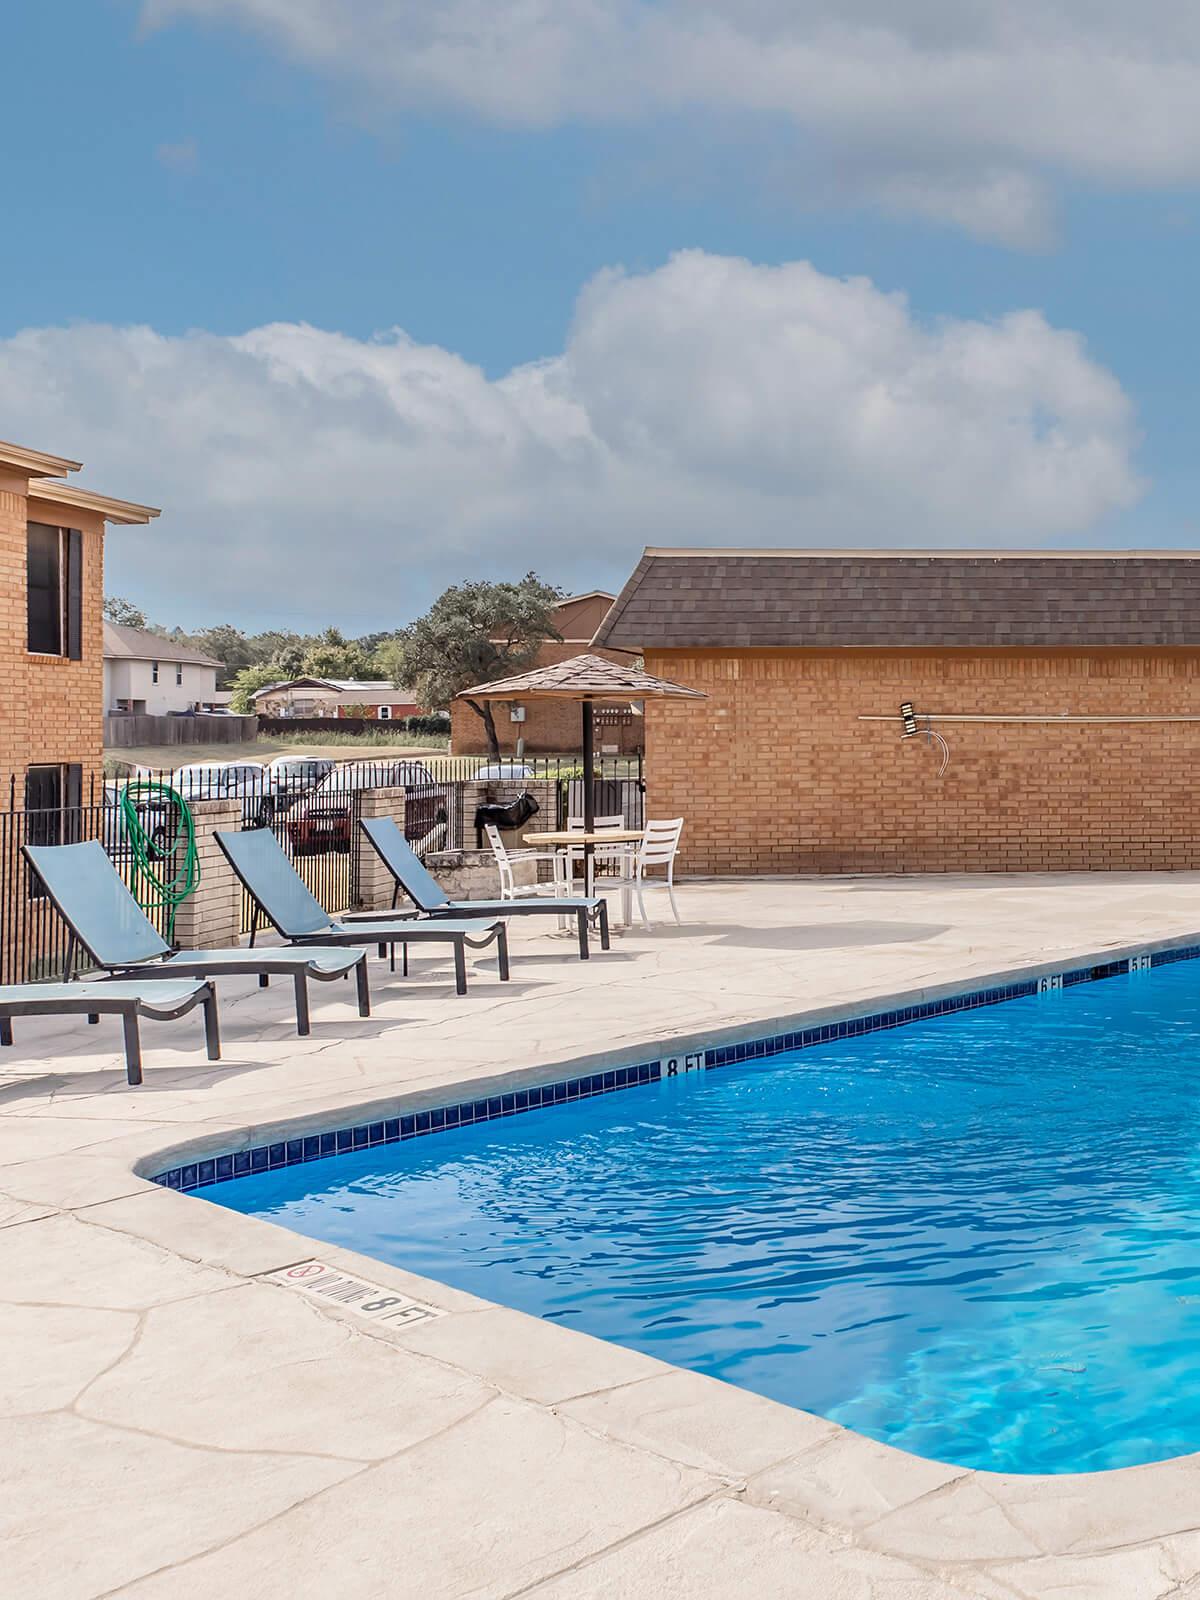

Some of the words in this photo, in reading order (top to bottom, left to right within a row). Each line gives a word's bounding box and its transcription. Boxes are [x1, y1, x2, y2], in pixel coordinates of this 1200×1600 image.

[1132, 959, 1138, 971] 5
[1141, 956, 1151, 970] FT
[1041, 978, 1048, 992] 6
[1051, 975, 1062, 989] FT
[667, 1059, 678, 1077] 8
[685, 1052, 703, 1073] FT
[360, 1296, 402, 1312] 8
[380, 1306, 439, 1327] FT
